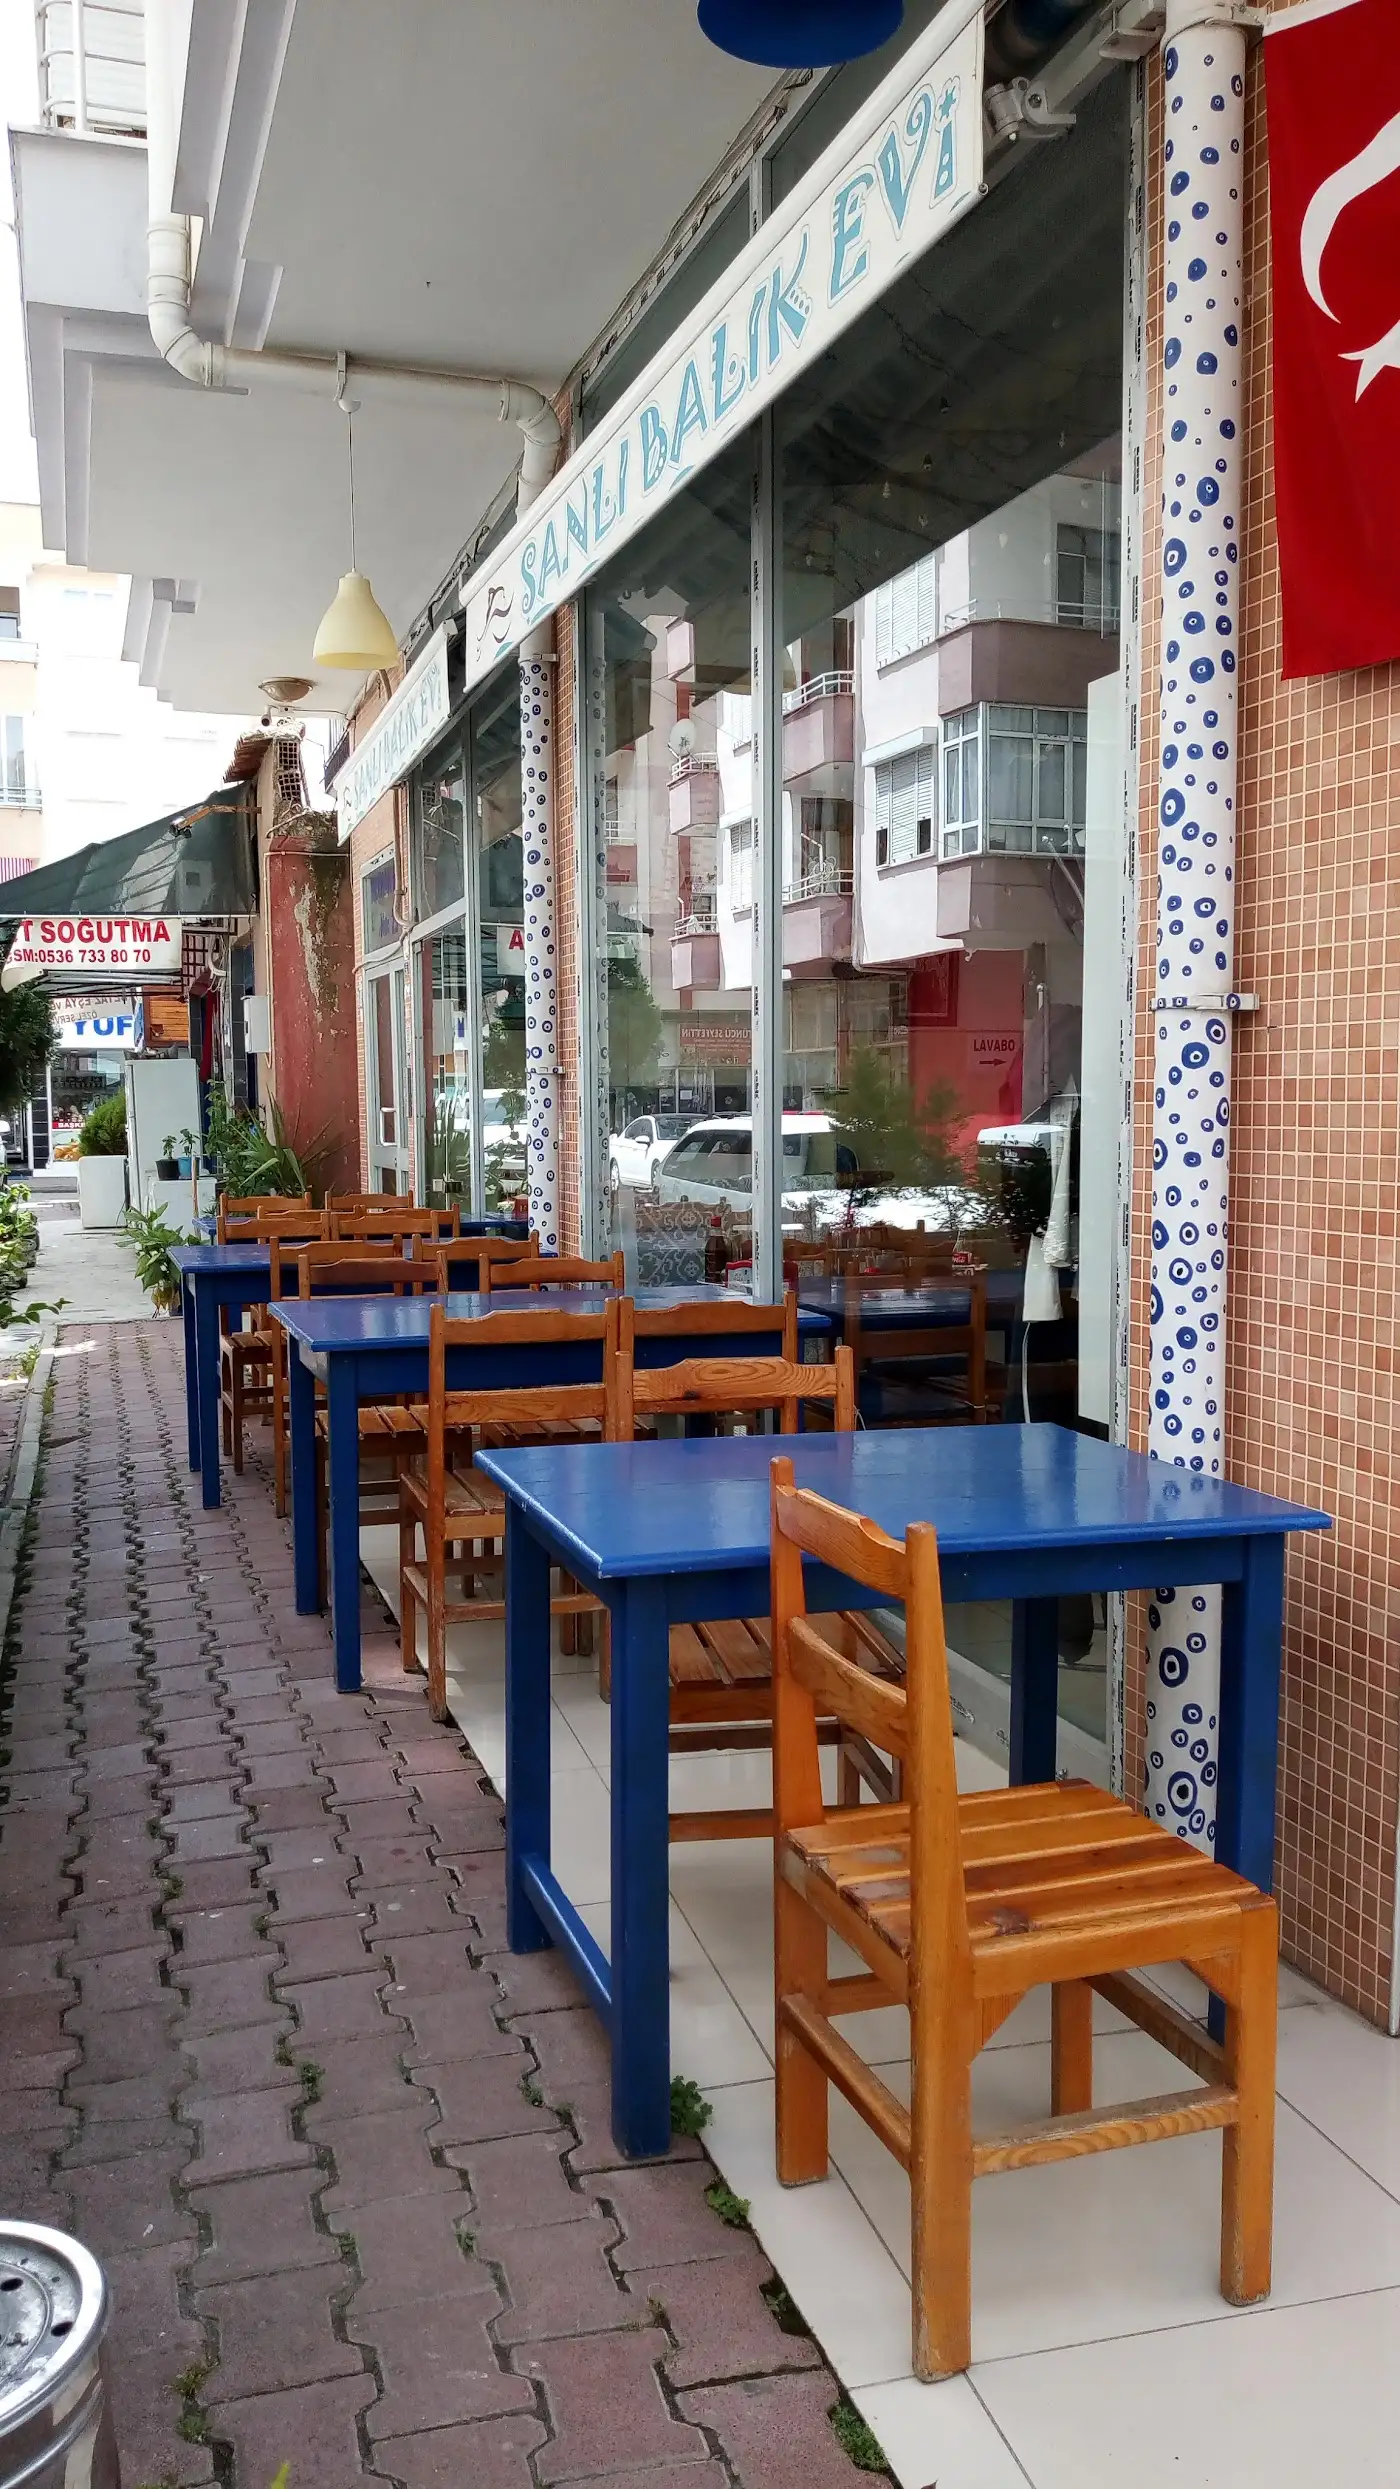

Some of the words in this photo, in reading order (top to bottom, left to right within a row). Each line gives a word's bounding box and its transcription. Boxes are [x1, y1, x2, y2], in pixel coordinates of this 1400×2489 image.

[639, 228, 810, 494] BALIK
[40, 918, 171, 944] SOĞUTMA
[78, 948, 106, 963] 733
[110, 949, 128, 963] 80
[133, 949, 151, 963] 70
[973, 1039, 1016, 1052] LAVABO
